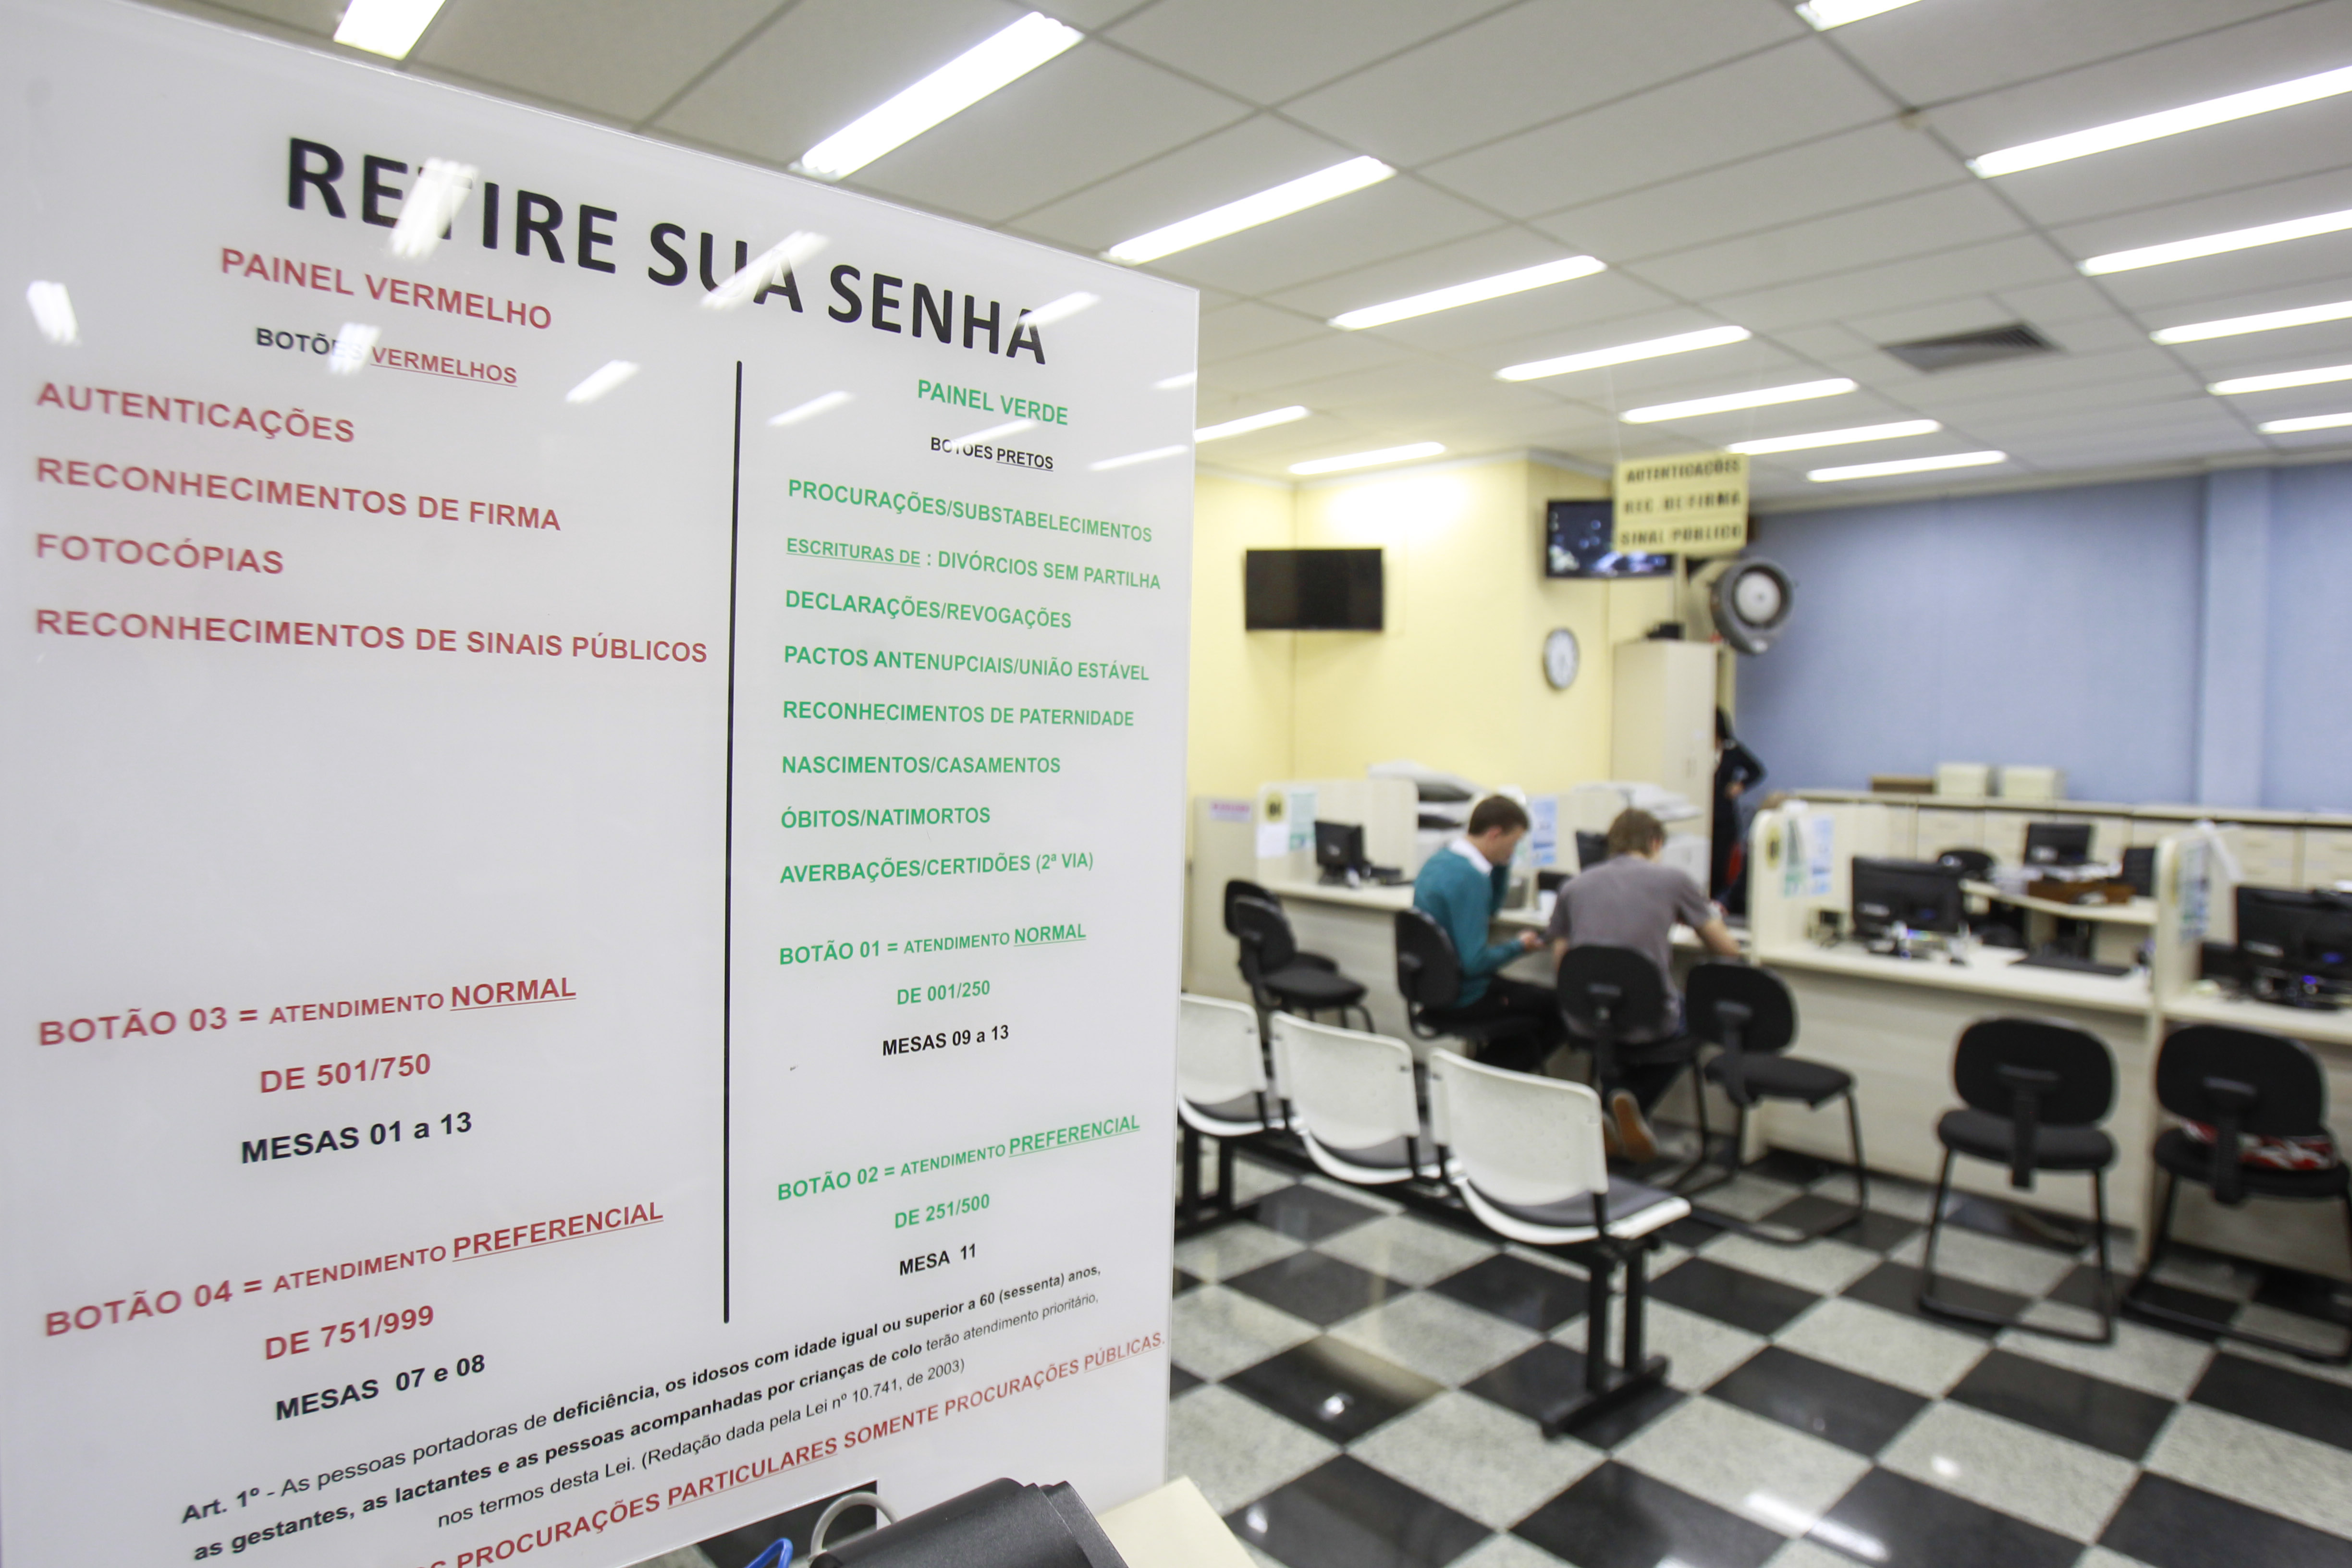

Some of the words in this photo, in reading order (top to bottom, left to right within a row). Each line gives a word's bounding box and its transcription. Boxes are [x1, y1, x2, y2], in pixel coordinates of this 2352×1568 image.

[221, 248, 354, 295] PAINEL
[365, 274, 551, 329] VERMELHO
[649, 223, 803, 313] SUA
[828, 265, 1045, 365] SENHA
[372, 347, 517, 384] VERMELHOS
[37, 382, 354, 442] AUTENTICAÇÕES
[919, 380, 994, 411] PAINEL
[1000, 395, 1067, 425] VERDE
[997, 448, 1053, 469] PRETOS
[37, 457, 406, 516] RECONHECIMENTOS
[418, 496, 459, 521] DE
[470, 501, 561, 531] FIRMA
[789, 479, 1152, 542] PROCURAÇÕES/SUBSTABELECIMENTOS
[37, 534, 283, 574] FOTOCÓPIAS
[786, 538, 894, 563] ESCRITURAS
[900, 550, 920, 565] DE
[938, 551, 1038, 576] DIVÓRCIOS
[1043, 563, 1078, 580] SEM
[1084, 567, 1160, 589] PARTILHA
[786, 590, 1071, 629] DECLARAÇÕES/REVOGAÇÕES
[36, 609, 404, 649] RECONHECIMENTOS
[416, 628, 457, 651] DE
[467, 631, 563, 656] SINAIS
[573, 632, 707, 662] PÚBLICOS
[785, 646, 868, 666] PACTOS
[873, 650, 1072, 676] ANTENUPCIAIS/UNIÃO
[1078, 660, 1149, 680] ESTÁVEL
[784, 701, 984, 723] RECONHECIMENTOS
[991, 707, 1014, 723] DE
[1020, 708, 1134, 726] PATERNIDADE
[783, 756, 1060, 773] NASCIMENTOS/CASAMENTOS
[781, 806, 990, 828] ÓBITOS/NATIMORTOS
[780, 853, 1030, 883] AVERBAÇÕES/CERTIDÕES
[1062, 852, 1093, 870] VIA)
[780, 940, 853, 965] BOTÃO
[860, 940, 879, 957] 01
[904, 932, 1010, 954] ATENDIMENTO
[1014, 924, 1086, 944] NORMAL
[38, 1008, 177, 1046] BOTÃO
[189, 1007, 228, 1031] 03
[269, 993, 444, 1024] ATENDIMENTO
[451, 977, 576, 1007] NORMAL
[897, 987, 921, 1005] DE
[927, 980, 990, 1001] 001/250
[883, 1033, 946, 1056] MESAS
[953, 1029, 971, 1046] 09
[977, 1031, 985, 1043] a
[992, 1025, 1009, 1041] 13
[260, 1067, 306, 1093] DE
[317, 1054, 430, 1086] 501/750
[241, 1127, 359, 1164] MESAS
[370, 1120, 400, 1145] 01
[414, 1123, 430, 1139] a
[441, 1112, 472, 1135] 13
[778, 1171, 851, 1200] BOTÃO
[857, 1166, 878, 1185] 02
[901, 1144, 1005, 1176] ATENDIMENTO
[1009, 1115, 1139, 1154] PREFERENCIAL
[895, 1209, 919, 1229] DE
[926, 1194, 990, 1222] 251/500
[45, 1290, 182, 1336] BOTÃO
[194, 1280, 233, 1307] 04
[273, 1246, 446, 1293] ATENDIMENTO
[453, 1202, 663, 1258] PREFERENCIAL
[900, 1250, 950, 1276] MESA
[960, 1243, 975, 1260] 11
[265, 1330, 310, 1360] DE
[320, 1305, 434, 1347] 751/999
[181, 1499, 227, 1524] Art.
[281, 1478, 310, 1497] As
[318, 1453, 406, 1491] pessoas
[413, 1423, 518, 1465] portadoras
[524, 1414, 547, 1430] de
[553, 1385, 659, 1422] deficiência,
[665, 1378, 686, 1392] os
[693, 1361, 749, 1385] idosos
[755, 1350, 789, 1368] com
[795, 1337, 836, 1358] idade
[842, 1323, 878, 1347] igual
[882, 1320, 900, 1333] ou
[906, 1303, 964, 1327] superior
[968, 1300, 975, 1310] a
[980, 1292, 995, 1306] 60
[999, 1273, 1064, 1304] (sessenta)
[1068, 1267, 1100, 1282] anos,
[276, 1379, 379, 1421] MESAS
[396, 1368, 425, 1391] 07
[434, 1368, 448, 1382] e
[456, 1354, 485, 1377] 08
[193, 1542, 223, 1560] as
[231, 1507, 355, 1554] gestantes,
[362, 1495, 388, 1512] as
[396, 1467, 491, 1503] lactantes
[498, 1461, 510, 1473] e
[516, 1453, 539, 1469] as
[546, 1429, 625, 1464] pessoas
[631, 1390, 762, 1436] acompanhadas
[768, 1380, 795, 1400] por
[799, 1361, 864, 1387] crianças
[869, 1354, 887, 1368] de
[892, 1344, 922, 1361] colo
[926, 1334, 959, 1351] terão
[964, 1311, 1039, 1340] atendimento
[1042, 1293, 1099, 1320] prioritário,
[439, 1507, 473, 1528] nos
[479, 1487, 544, 1515] termos
[550, 1470, 599, 1494] desta
[606, 1457, 635, 1478] Lei.
[642, 1434, 721, 1470] (Redação
[726, 1421, 764, 1441] dada
[770, 1409, 801, 1432] pela
[807, 1402, 827, 1417] Lei
[853, 1378, 902, 1403] 10.741,
[907, 1373, 923, 1386] de
[928, 1359, 964, 1381] 2003)
[457, 1494, 660, 1568] PROCURAÇÕES
[668, 1437, 837, 1506] PARTICULARES
[844, 1404, 938, 1448] SOMENTE
[945, 1360, 1079, 1416] PROCURAÇÕES
[1085, 1332, 1165, 1371] PÚBLICAS.
